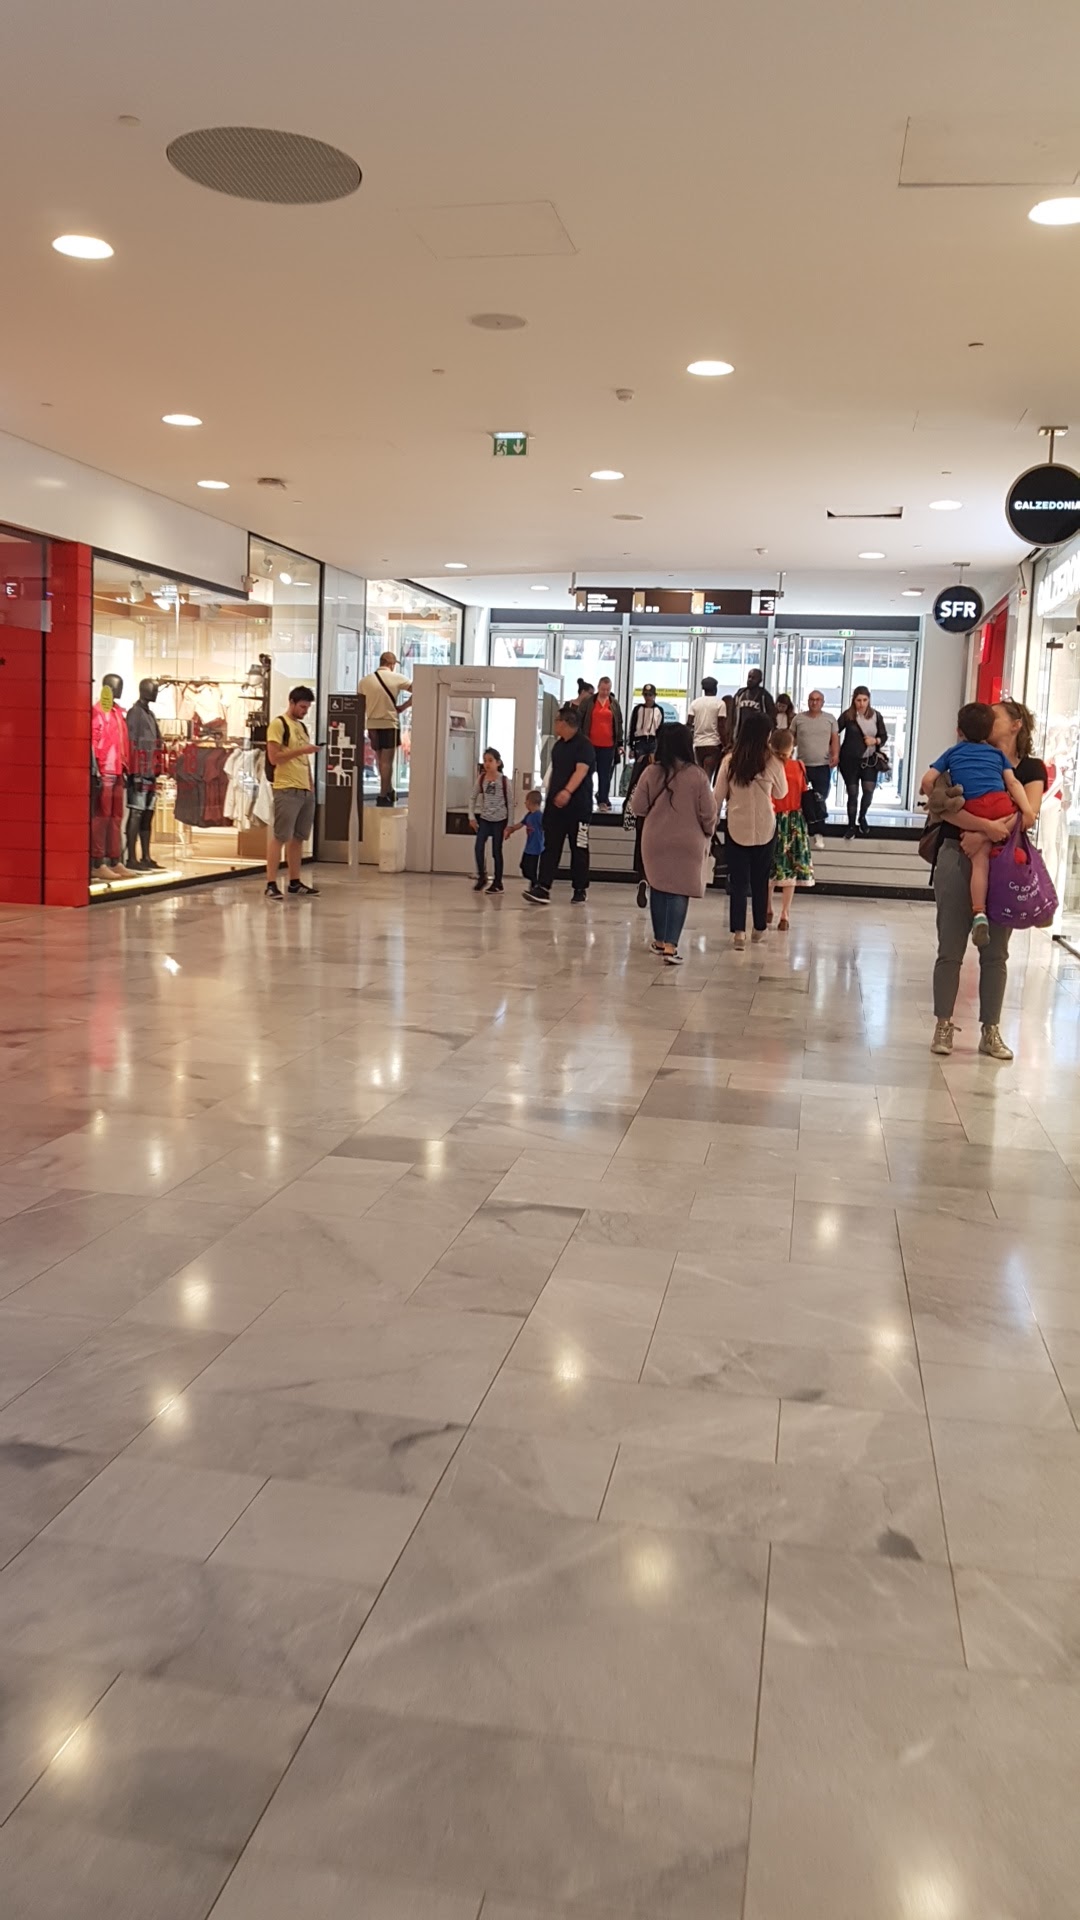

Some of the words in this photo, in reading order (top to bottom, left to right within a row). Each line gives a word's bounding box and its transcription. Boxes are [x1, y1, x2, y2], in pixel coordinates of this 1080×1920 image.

[1014, 500, 1080, 511] CALZEDONIA
[940, 600, 977, 618] SFR
[576, 821, 589, 849] NIKE
